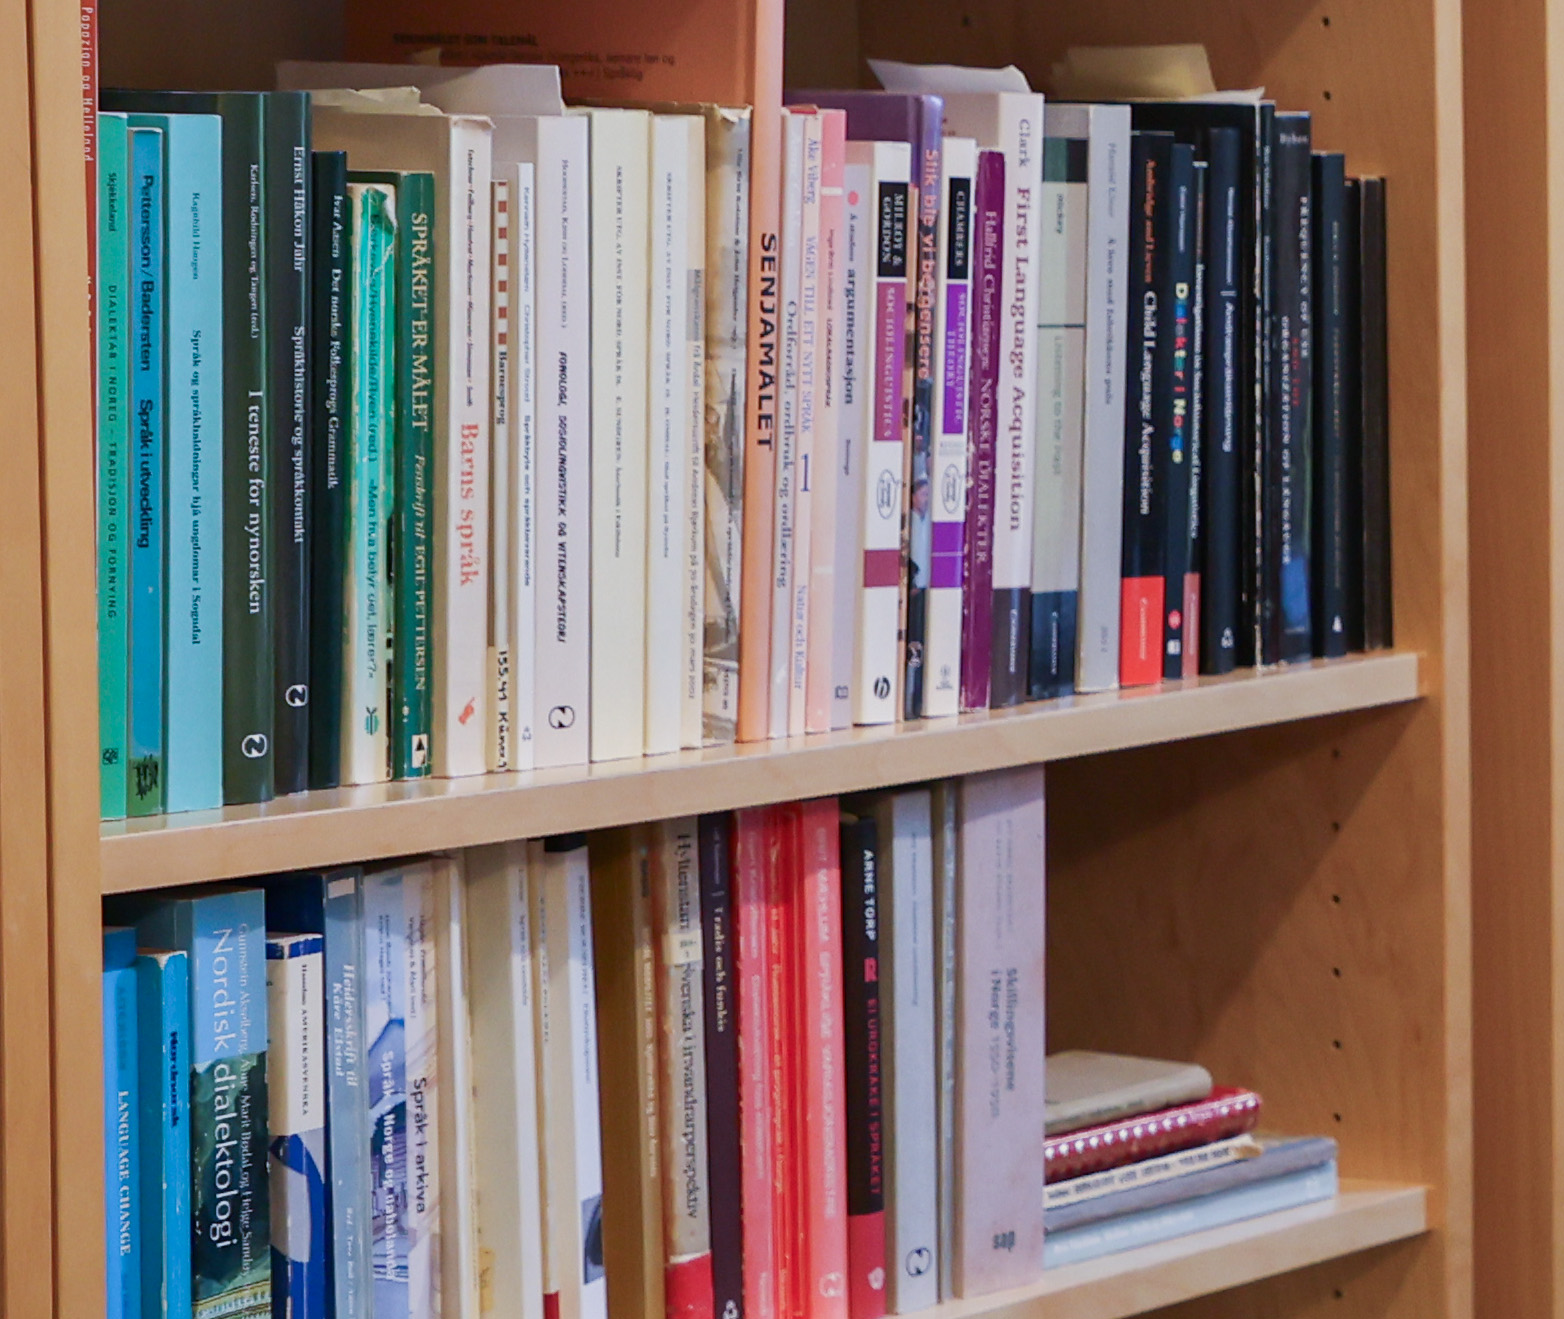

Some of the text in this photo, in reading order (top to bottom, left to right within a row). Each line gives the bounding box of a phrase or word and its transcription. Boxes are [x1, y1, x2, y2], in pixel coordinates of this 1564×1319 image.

[882, 197, 892, 263] GORDON
[893, 194, 904, 250] MILROY
[330, 269, 341, 292] Det
[412, 213, 431, 313] SPRÅKET
[801, 137, 819, 433] Åke Viberg TILL ETT NYTT SPRÅK
[918, 150, 938, 379] Slik ble vi bergensere
[108, 285, 118, 359] DIALEKTAR
[191, 330, 202, 367] Språk
[291, 146, 306, 543] Ernst Håkon Jahr Språkhistorie og språkkontakt
[330, 296, 339, 336] norske
[412, 320, 428, 347] ER
[758, 233, 777, 452] SENJAMÅLET
[784, 301, 797, 394] Ordforråd,
[844, 268, 857, 404] argumentasjon
[1008, 119, 1031, 531] Clark First Language Acquisition
[108, 376, 118, 422] NOREG
[412, 355, 431, 432] MÅLET
[497, 351, 508, 424] Barnesprog
[1139, 291, 1157, 514] Child Language Acquisition
[138, 399, 153, 448] Språk
[248, 405, 262, 473] teneste
[327, 417, 339, 489] Grammatik
[782, 401, 795, 470] ordbruk
[107, 443, 117, 517] TRADISJON
[137, 461, 154, 548] utveckling
[191, 496, 202, 516] hjå
[249, 478, 263, 508] for
[456, 424, 481, 586] Barns språk
[191, 520, 201, 583] ungdomar
[245, 513, 263, 614] nynorsken
[366, 553, 377, 589] betyr
[777, 504, 790, 588] ordlæring
[107, 549, 117, 618] FORNYING
[191, 595, 202, 644] Sogndal
[863, 850, 878, 941] ARNE TORP
[989, 980, 1002, 1030] Norge
[210, 928, 238, 1248] Nordisk dialektologi
[346, 1071, 357, 1086] til
[381, 1051, 395, 1097] Språk
[410, 1078, 429, 1134] Språk
[117, 1090, 131, 1256] LANGUAGE CHANGE
[381, 1114, 396, 1165] Norge
[381, 1170, 395, 1190] og
[414, 1154, 429, 1213] arkiva
